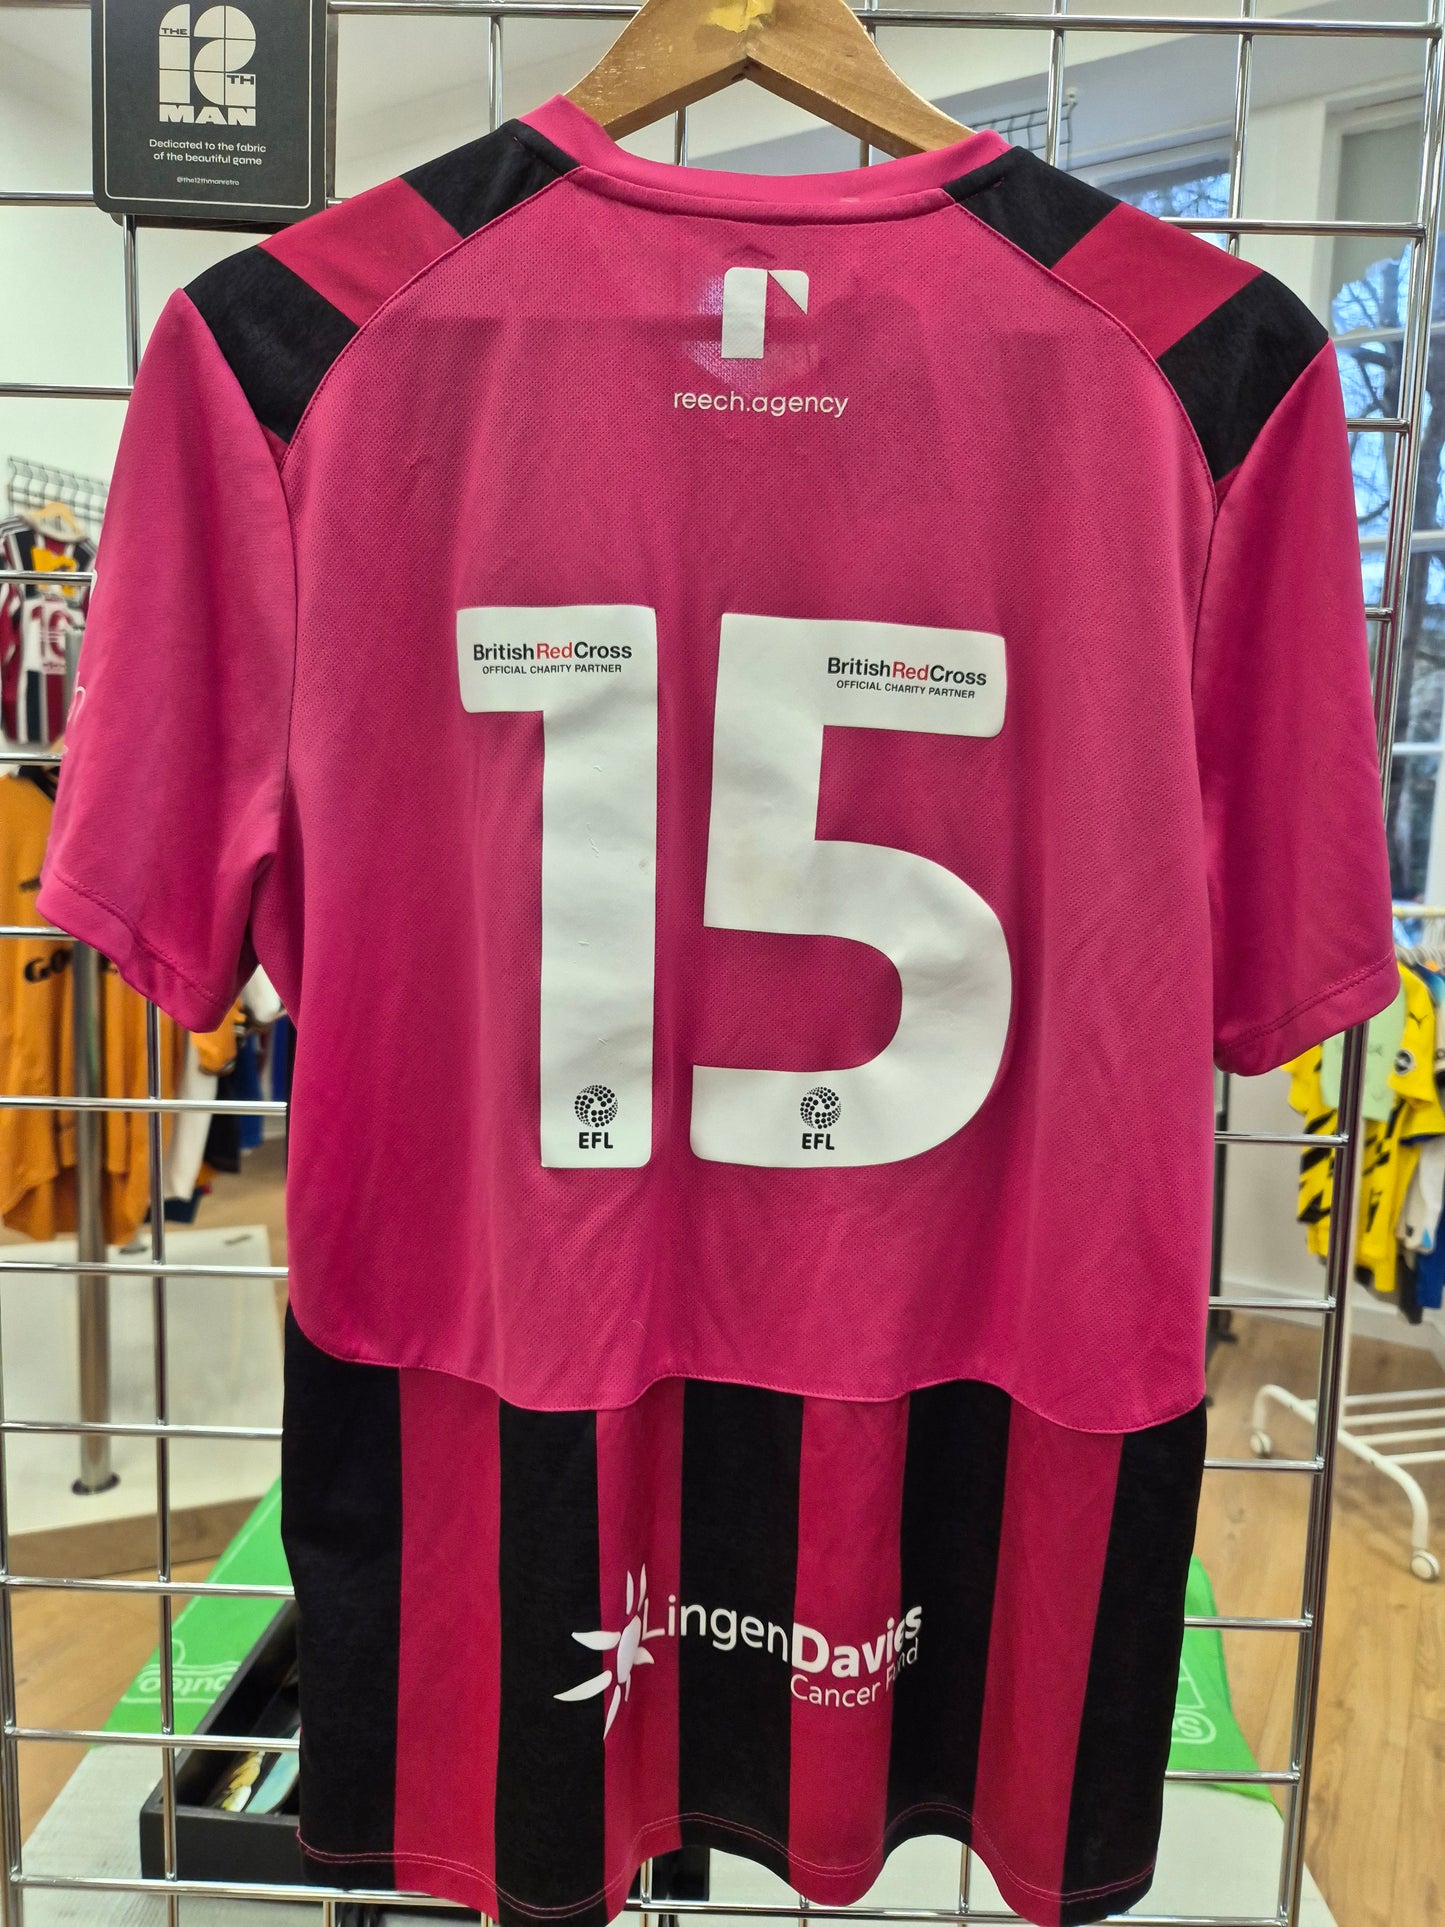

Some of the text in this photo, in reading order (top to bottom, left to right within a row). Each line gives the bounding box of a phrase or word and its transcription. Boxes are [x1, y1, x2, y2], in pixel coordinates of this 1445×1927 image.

[161, 27, 188, 35] THE
[158, 104, 257, 127] MAN
[149, 138, 267, 153] Dedicated to the fabric
[153, 151, 262, 166] of the beautiful game
[176, 176, 240, 186] @the12thmanretro
[673, 390, 849, 419] reech.agency
[482, 664, 622, 675] OFFICIAL CHARITY PARTNER
[836, 679, 976, 699] OFFICIAL CHARITY PARTNER
[456, 604, 1012, 1169] 15
[578, 1131, 614, 1150] EFL
[801, 1132, 836, 1151] EFL
[789, 1673, 881, 1708] Cancer
